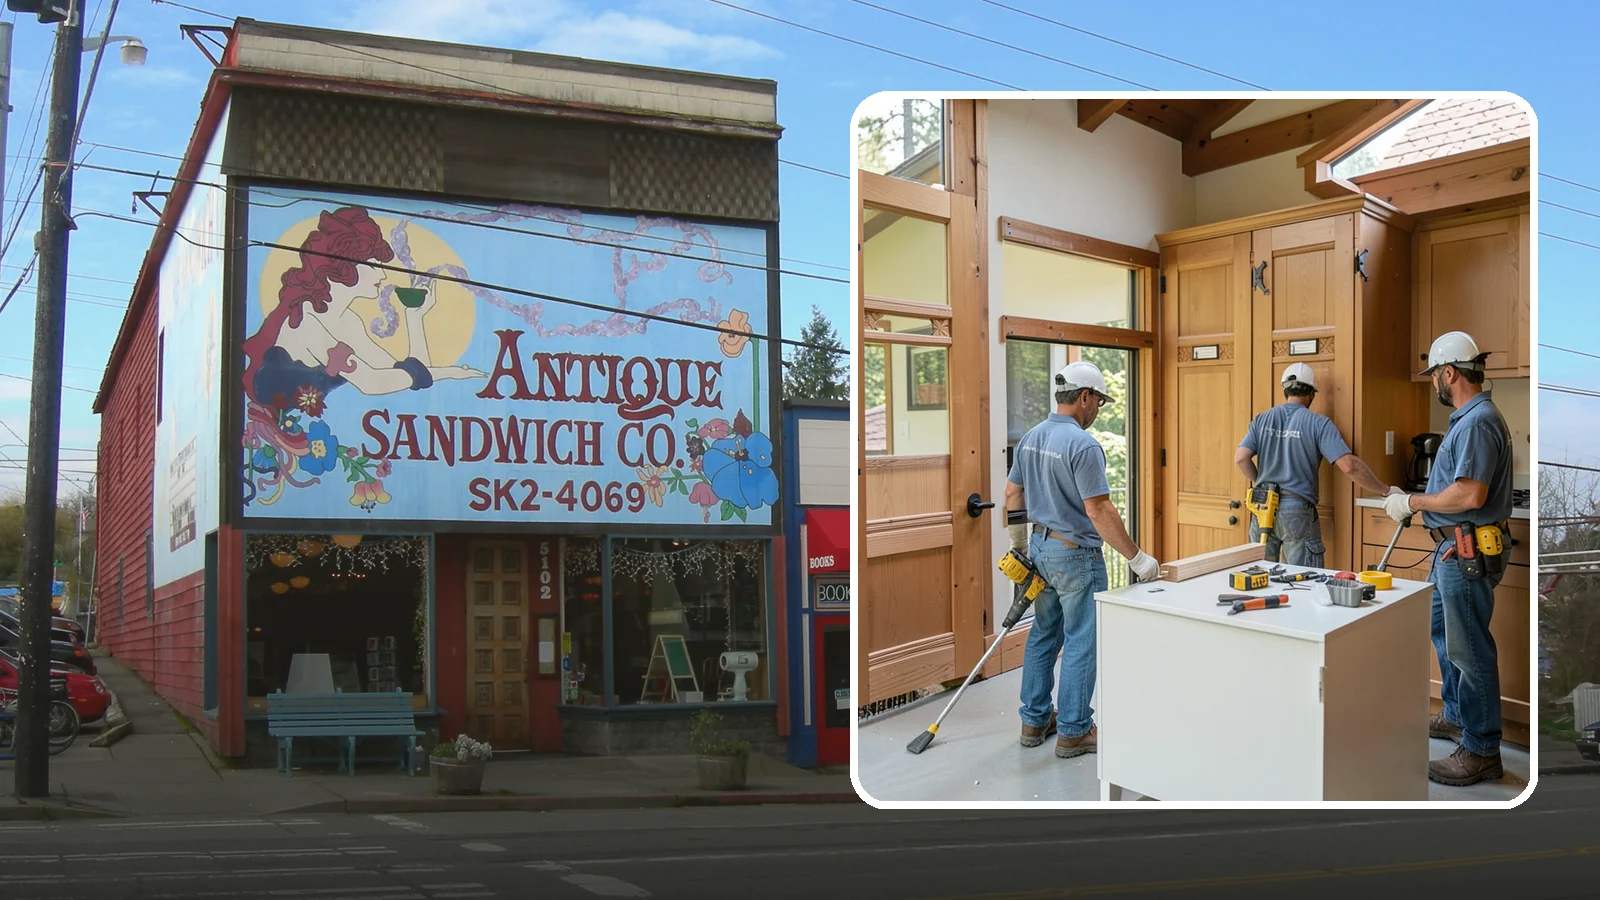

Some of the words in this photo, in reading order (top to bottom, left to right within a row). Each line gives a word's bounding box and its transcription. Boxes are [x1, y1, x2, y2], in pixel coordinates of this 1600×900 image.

[477, 329, 723, 421] ANTIQUE
[361, 408, 605, 468] SANDWICH
[616, 421, 687, 469] CO.
[468, 477, 646, 514] SK2-4069
[540, 542, 552, 600] 5102
[809, 555, 835, 569] BOOKS
